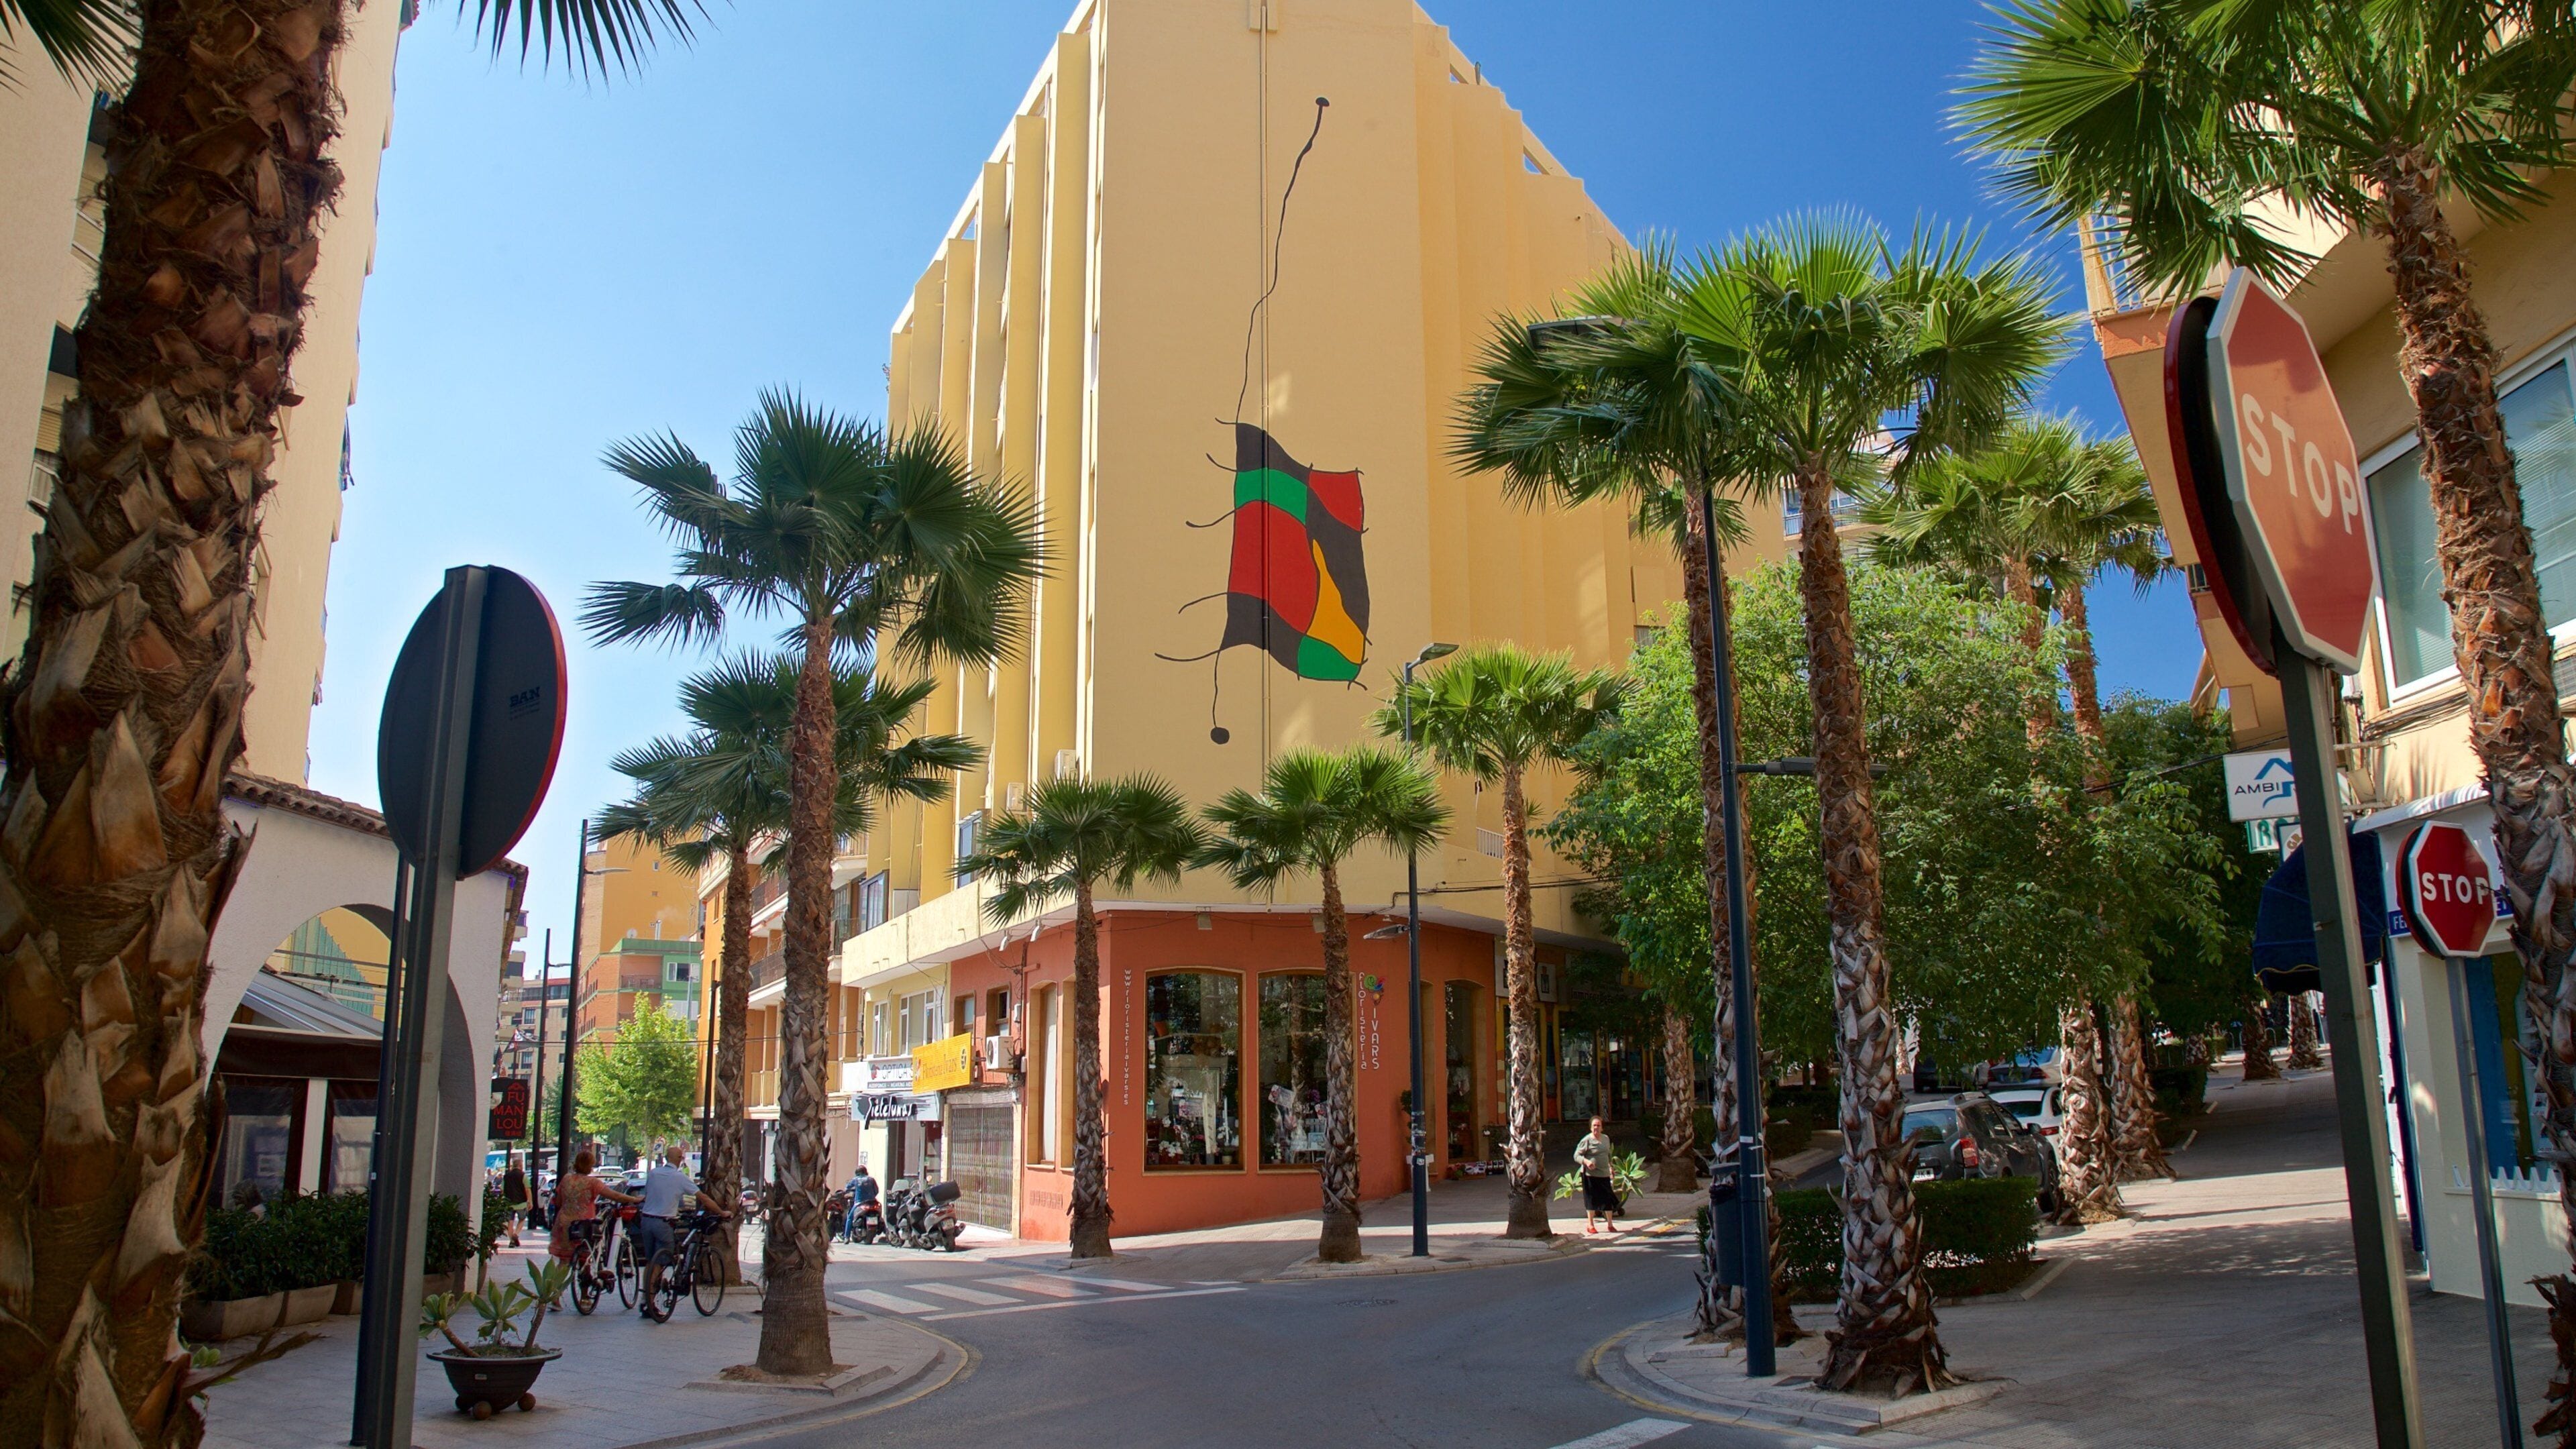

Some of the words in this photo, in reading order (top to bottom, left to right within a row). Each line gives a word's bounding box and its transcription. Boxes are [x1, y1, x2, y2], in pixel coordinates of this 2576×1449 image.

[2241, 392, 2359, 536] STOP
[2235, 782, 2279, 796] AMBI
[2421, 871, 2489, 905] STOP
[1371, 1008, 1380, 1070] IVARS
[508, 1091, 525, 1103] FU
[494, 1106, 524, 1116] MAN
[496, 1118, 523, 1130] LOU
